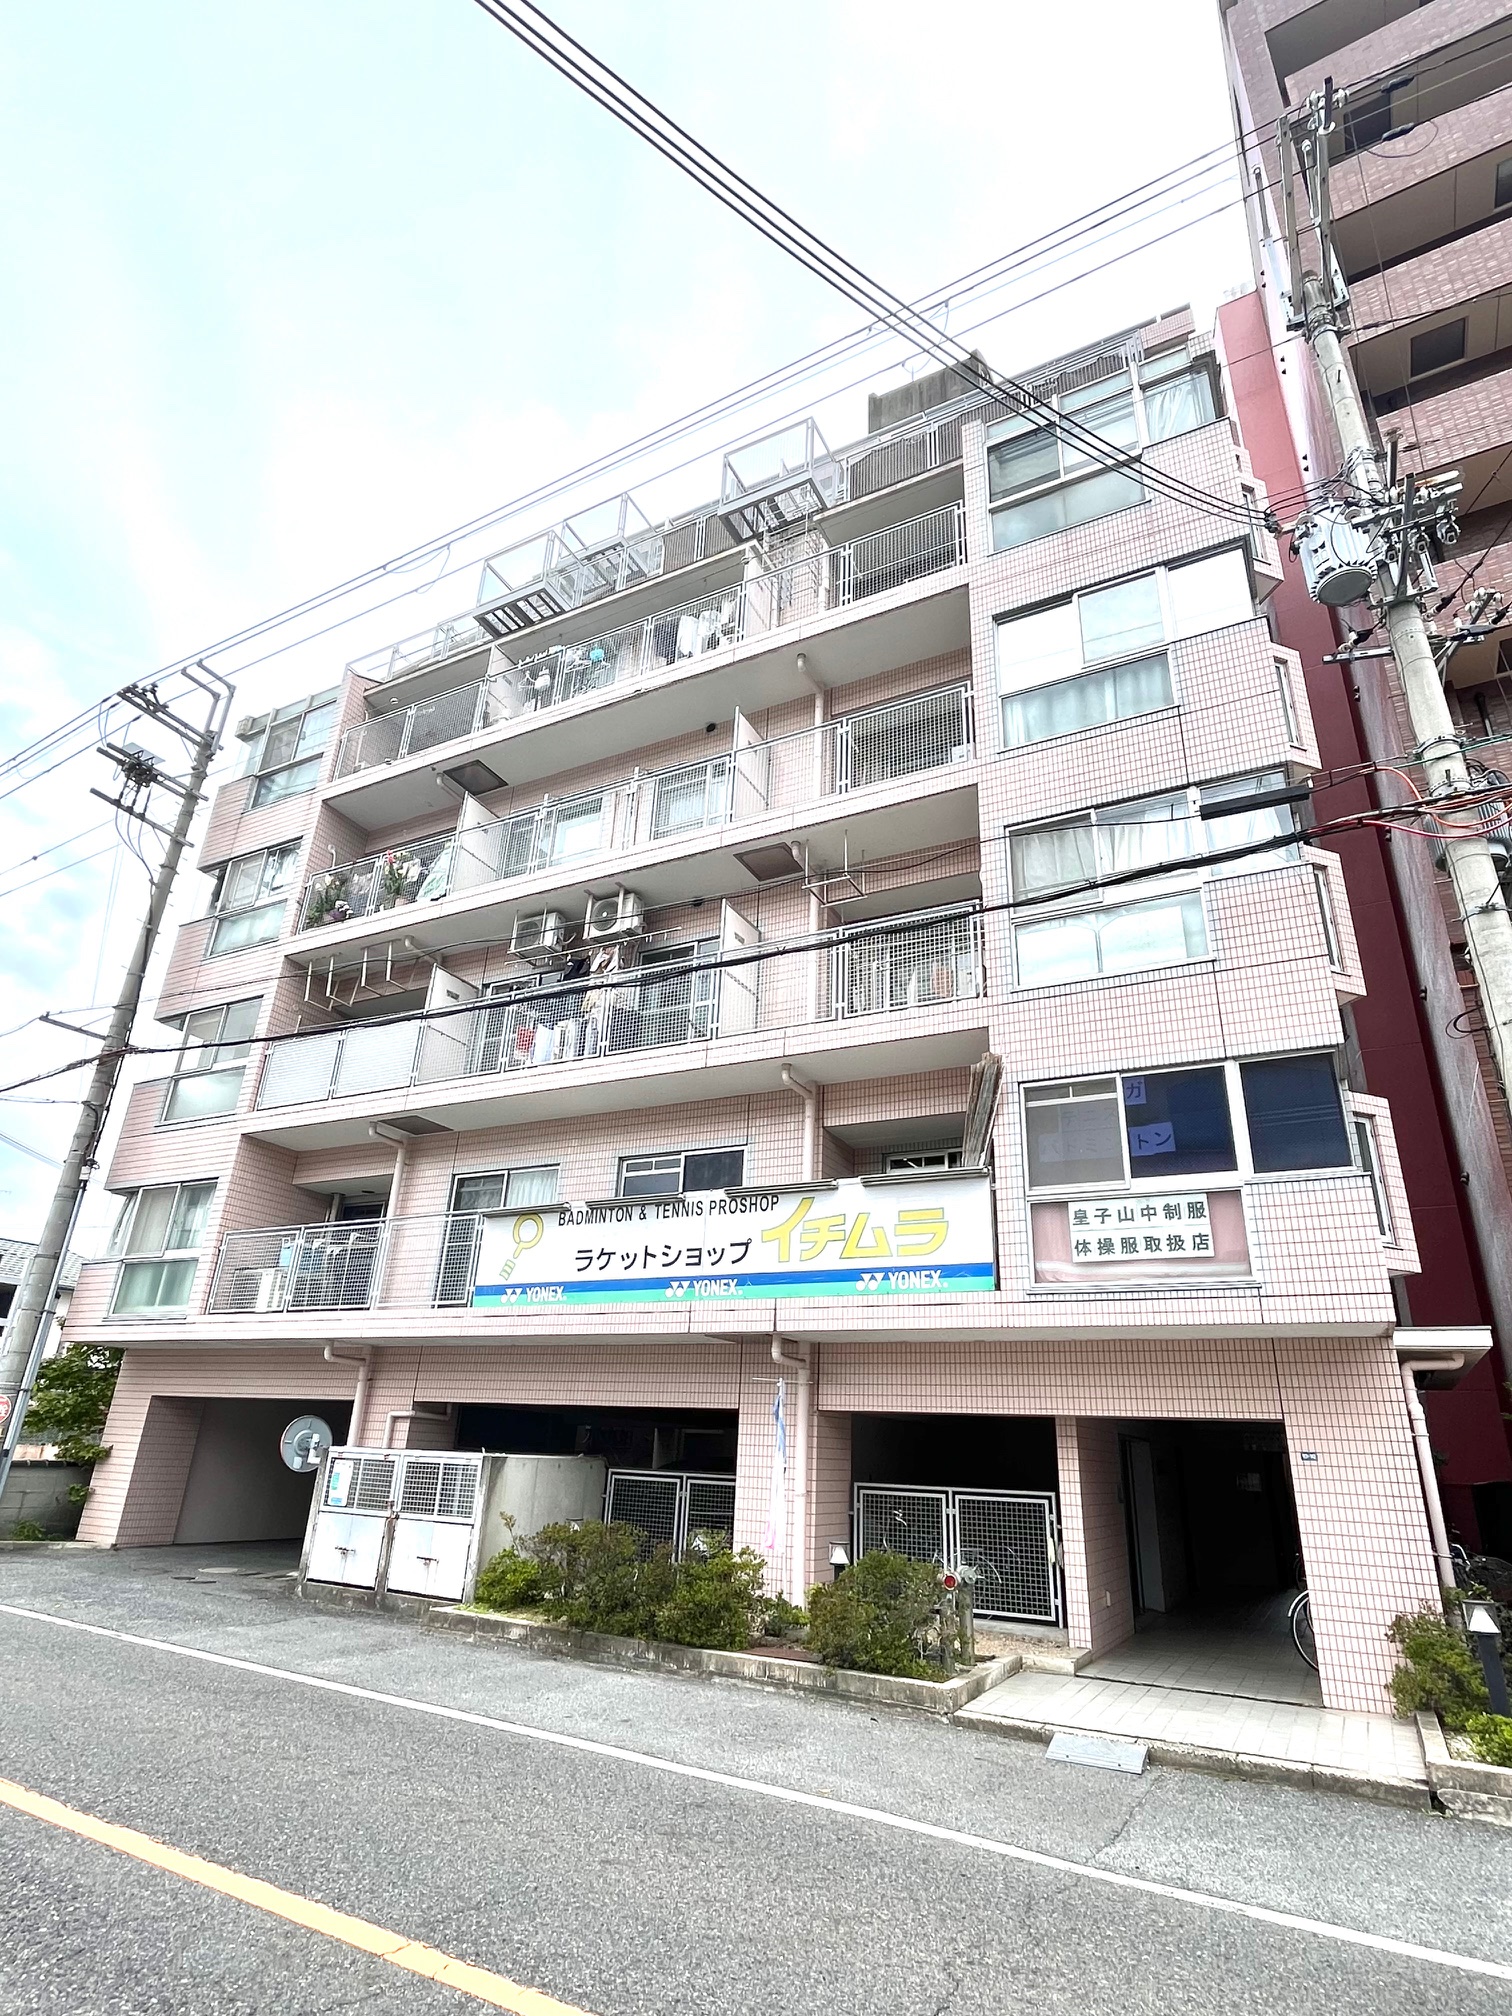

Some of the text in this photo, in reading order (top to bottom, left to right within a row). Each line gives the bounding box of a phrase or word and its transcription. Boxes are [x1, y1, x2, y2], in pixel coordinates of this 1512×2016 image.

[1125, 1081, 1143, 1099] ガ
[1137, 1132, 1172, 1150] トン
[558, 1195, 780, 1226] BADMINTON & TENNIS PROSHOP
[1072, 1201, 1207, 1226] 皇子山中制服
[575, 1196, 949, 1272] ラケットショップ イチムラ
[1074, 1232, 1210, 1257] 体操服取扱店
